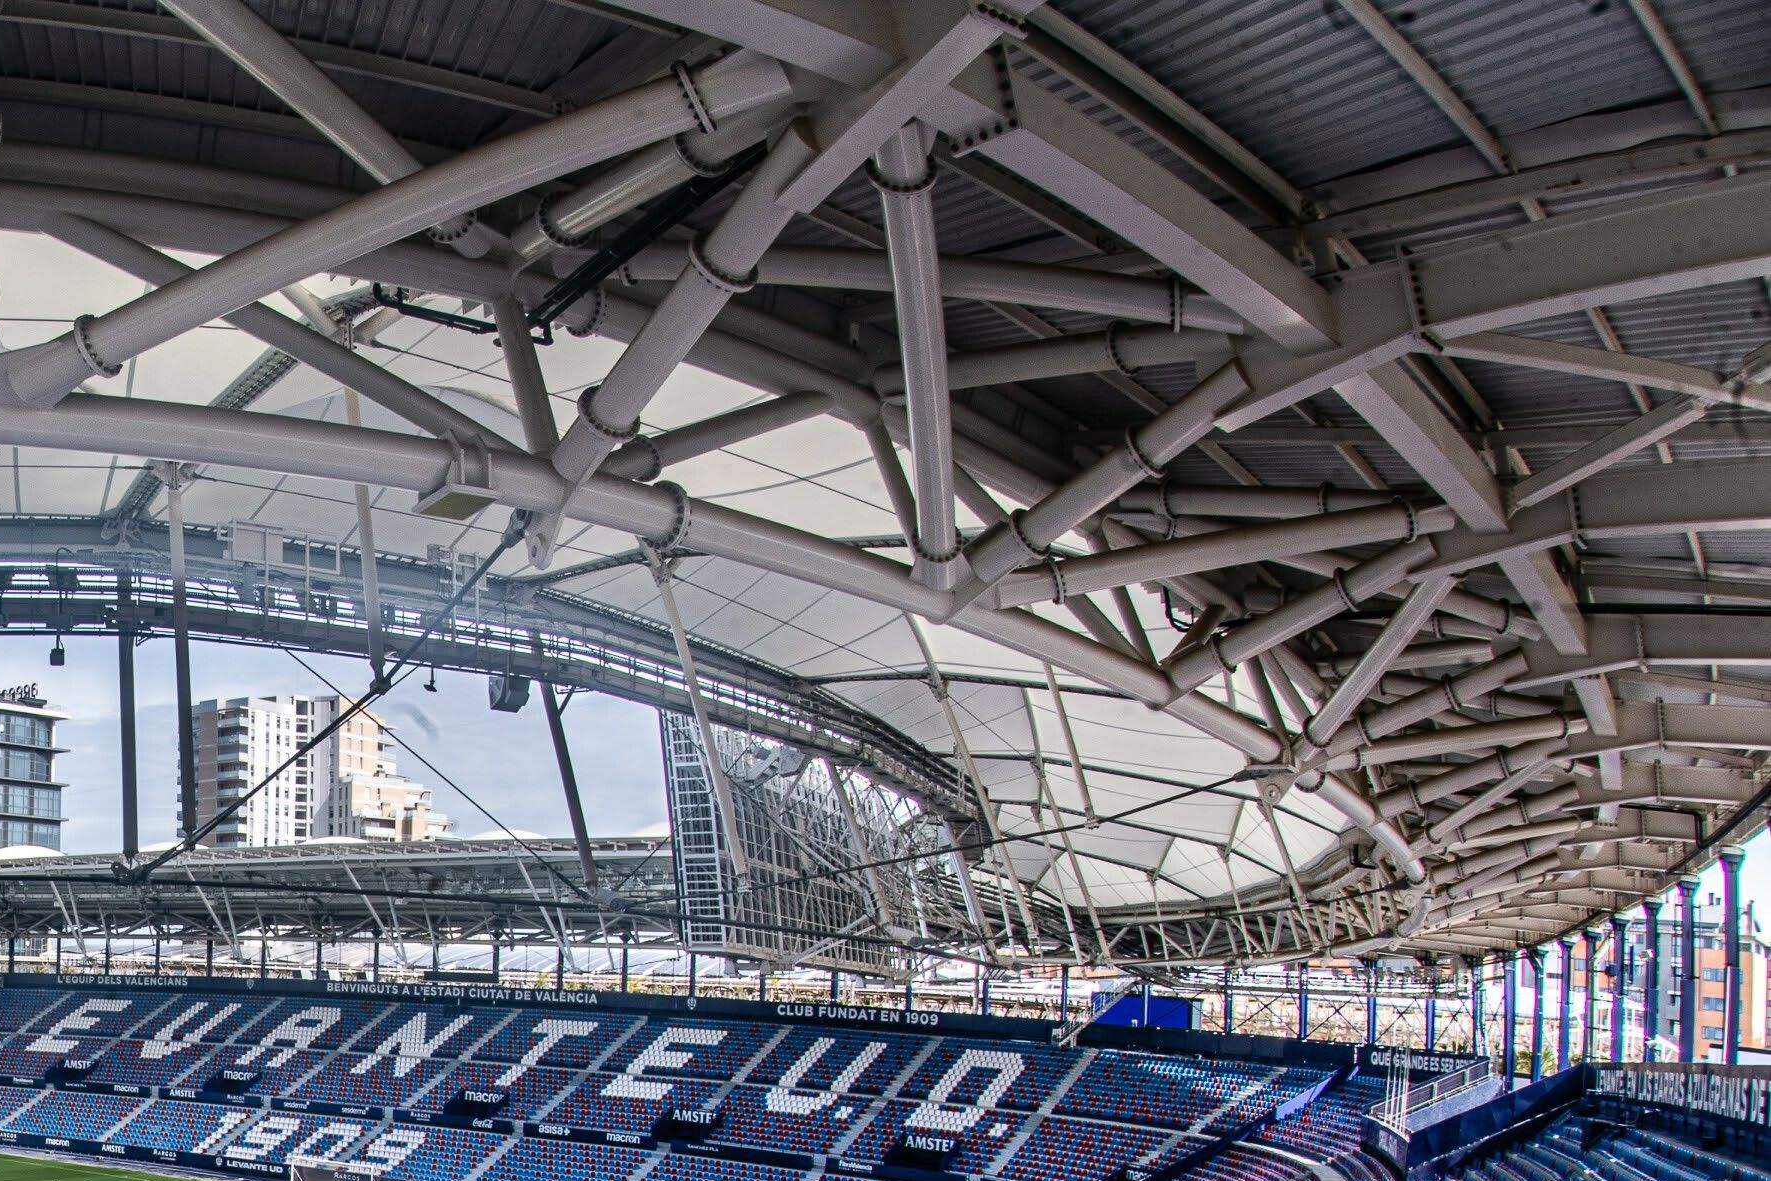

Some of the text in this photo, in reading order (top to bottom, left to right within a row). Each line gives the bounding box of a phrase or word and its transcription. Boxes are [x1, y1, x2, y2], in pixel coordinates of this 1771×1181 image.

[57, 975, 188, 986] L'EQUIP DELS VALENCIANS
[326, 982, 399, 995] BENVINGUTS
[402, 986, 410, 995] A
[414, 985, 465, 997] L'ESTADI
[469, 988, 511, 1000] CIUTAT
[515, 990, 531, 1000] DE
[777, 1004, 939, 1026] CLUB FUNDAT EN 1909
[1430, 1056, 1439, 1072] ES
[113, 1084, 139, 1094] macron
[169, 1088, 196, 1098] AMSTEL
[1653, 1072, 1685, 1106] BARRAS
[1686, 1073, 1748, 1121] AZULGRANAS
[1750, 1078, 1765, 1125] DE
[538, 1124, 563, 1135] asisa
[45, 1138, 70, 1147] macron
[606, 1132, 640, 1145] macron
[101, 1144, 126, 1154] AMSTEL
[227, 1160, 284, 1173] LEVANTE UD
